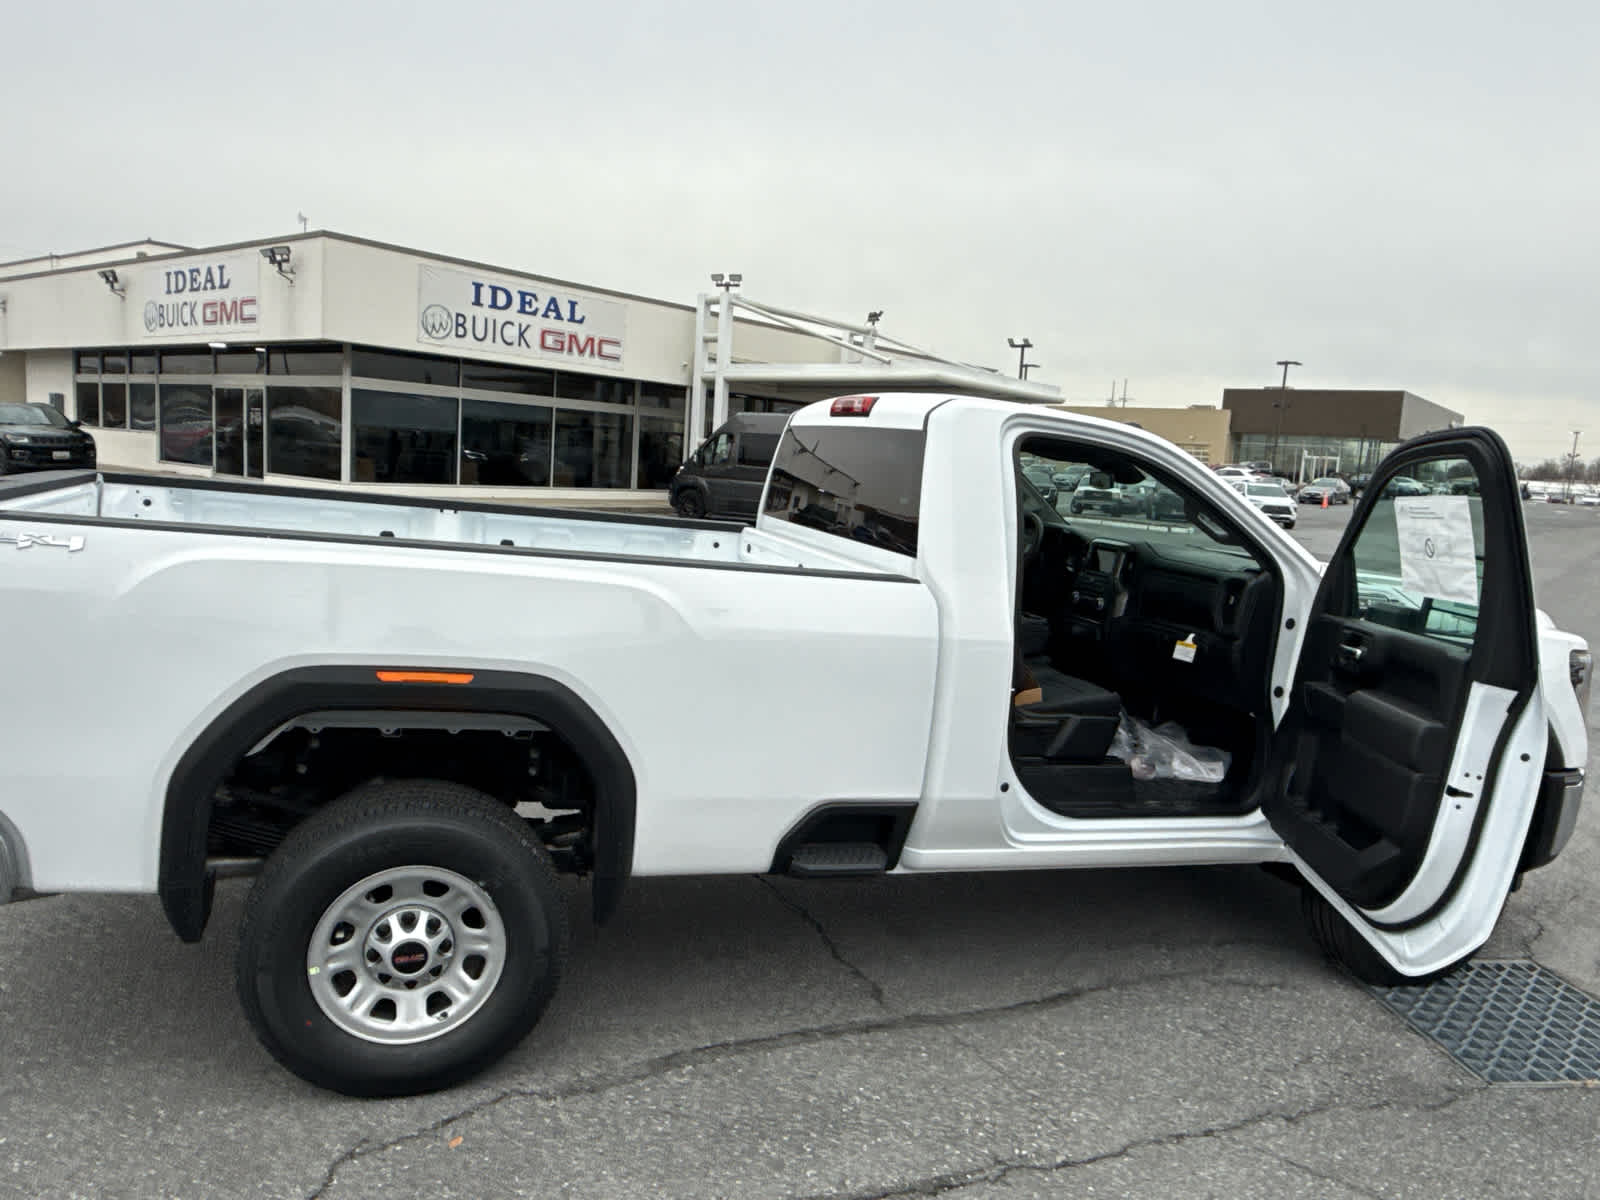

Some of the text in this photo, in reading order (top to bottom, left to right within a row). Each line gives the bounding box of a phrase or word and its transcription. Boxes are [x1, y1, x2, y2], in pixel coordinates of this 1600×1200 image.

[165, 265, 231, 294] IDEAL
[158, 298, 257, 328] BUICK GMC
[472, 282, 586, 324] IDEAL
[455, 312, 621, 361] BUICK GMC
